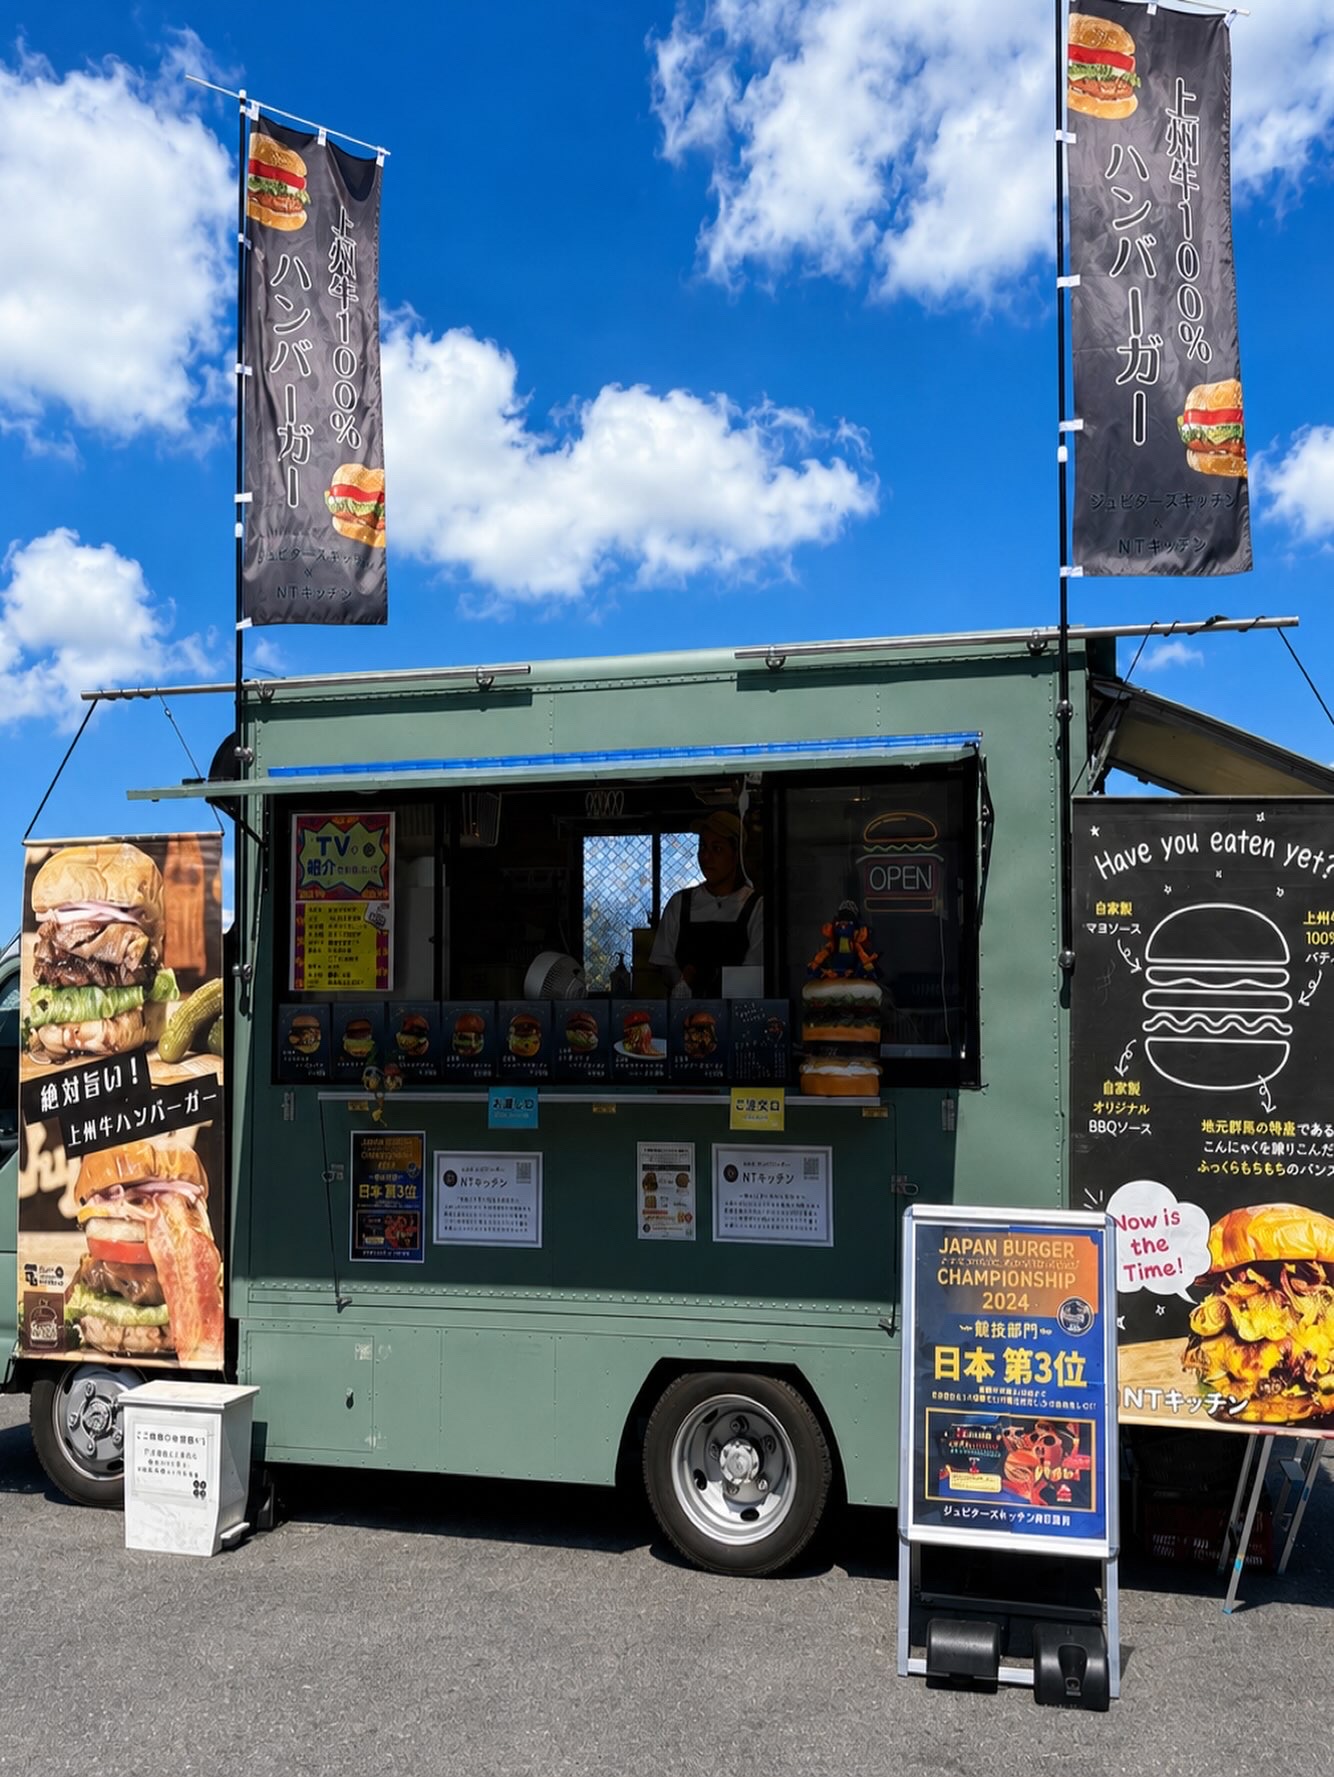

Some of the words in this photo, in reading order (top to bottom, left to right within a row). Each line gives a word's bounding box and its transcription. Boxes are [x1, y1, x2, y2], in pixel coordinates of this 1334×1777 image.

[1166, 77, 1212, 365] 上州牛100%
[1104, 143, 1163, 447] ハンバーガー
[327, 206, 362, 449] 上州牛100%
[269, 252, 313, 506] ハンバーガー
[316, 836, 350, 856] TV
[1094, 843, 1152, 880] Have
[1160, 832, 1199, 861] you
[1210, 829, 1275, 858] eaten
[869, 865, 932, 891] OPEN
[1095, 901, 1133, 917] 自家製
[1086, 923, 1142, 935] マヨソース
[40, 1057, 139, 1113] 絶対旨い！
[1103, 1080, 1141, 1097] 自家製
[68, 1089, 217, 1147] 上州牛ハンバーガー
[1092, 1101, 1150, 1116] オリジナル
[1088, 1120, 1152, 1137] BBQソース
[1115, 1214, 1157, 1231] Now
[1163, 1208, 1180, 1227] is
[939, 1237, 997, 1257] JAPAN
[1003, 1240, 1075, 1258] BURGER
[1130, 1237, 1169, 1256] the
[937, 1268, 1076, 1289] CHAMPIONSHIP
[1123, 1257, 1183, 1282] Time!
[982, 1292, 1030, 1312] 2024
[934, 1346, 995, 1383] 日本
[1003, 1347, 1088, 1388] 第3位
[1124, 1387, 1249, 1415] NTキッチン
